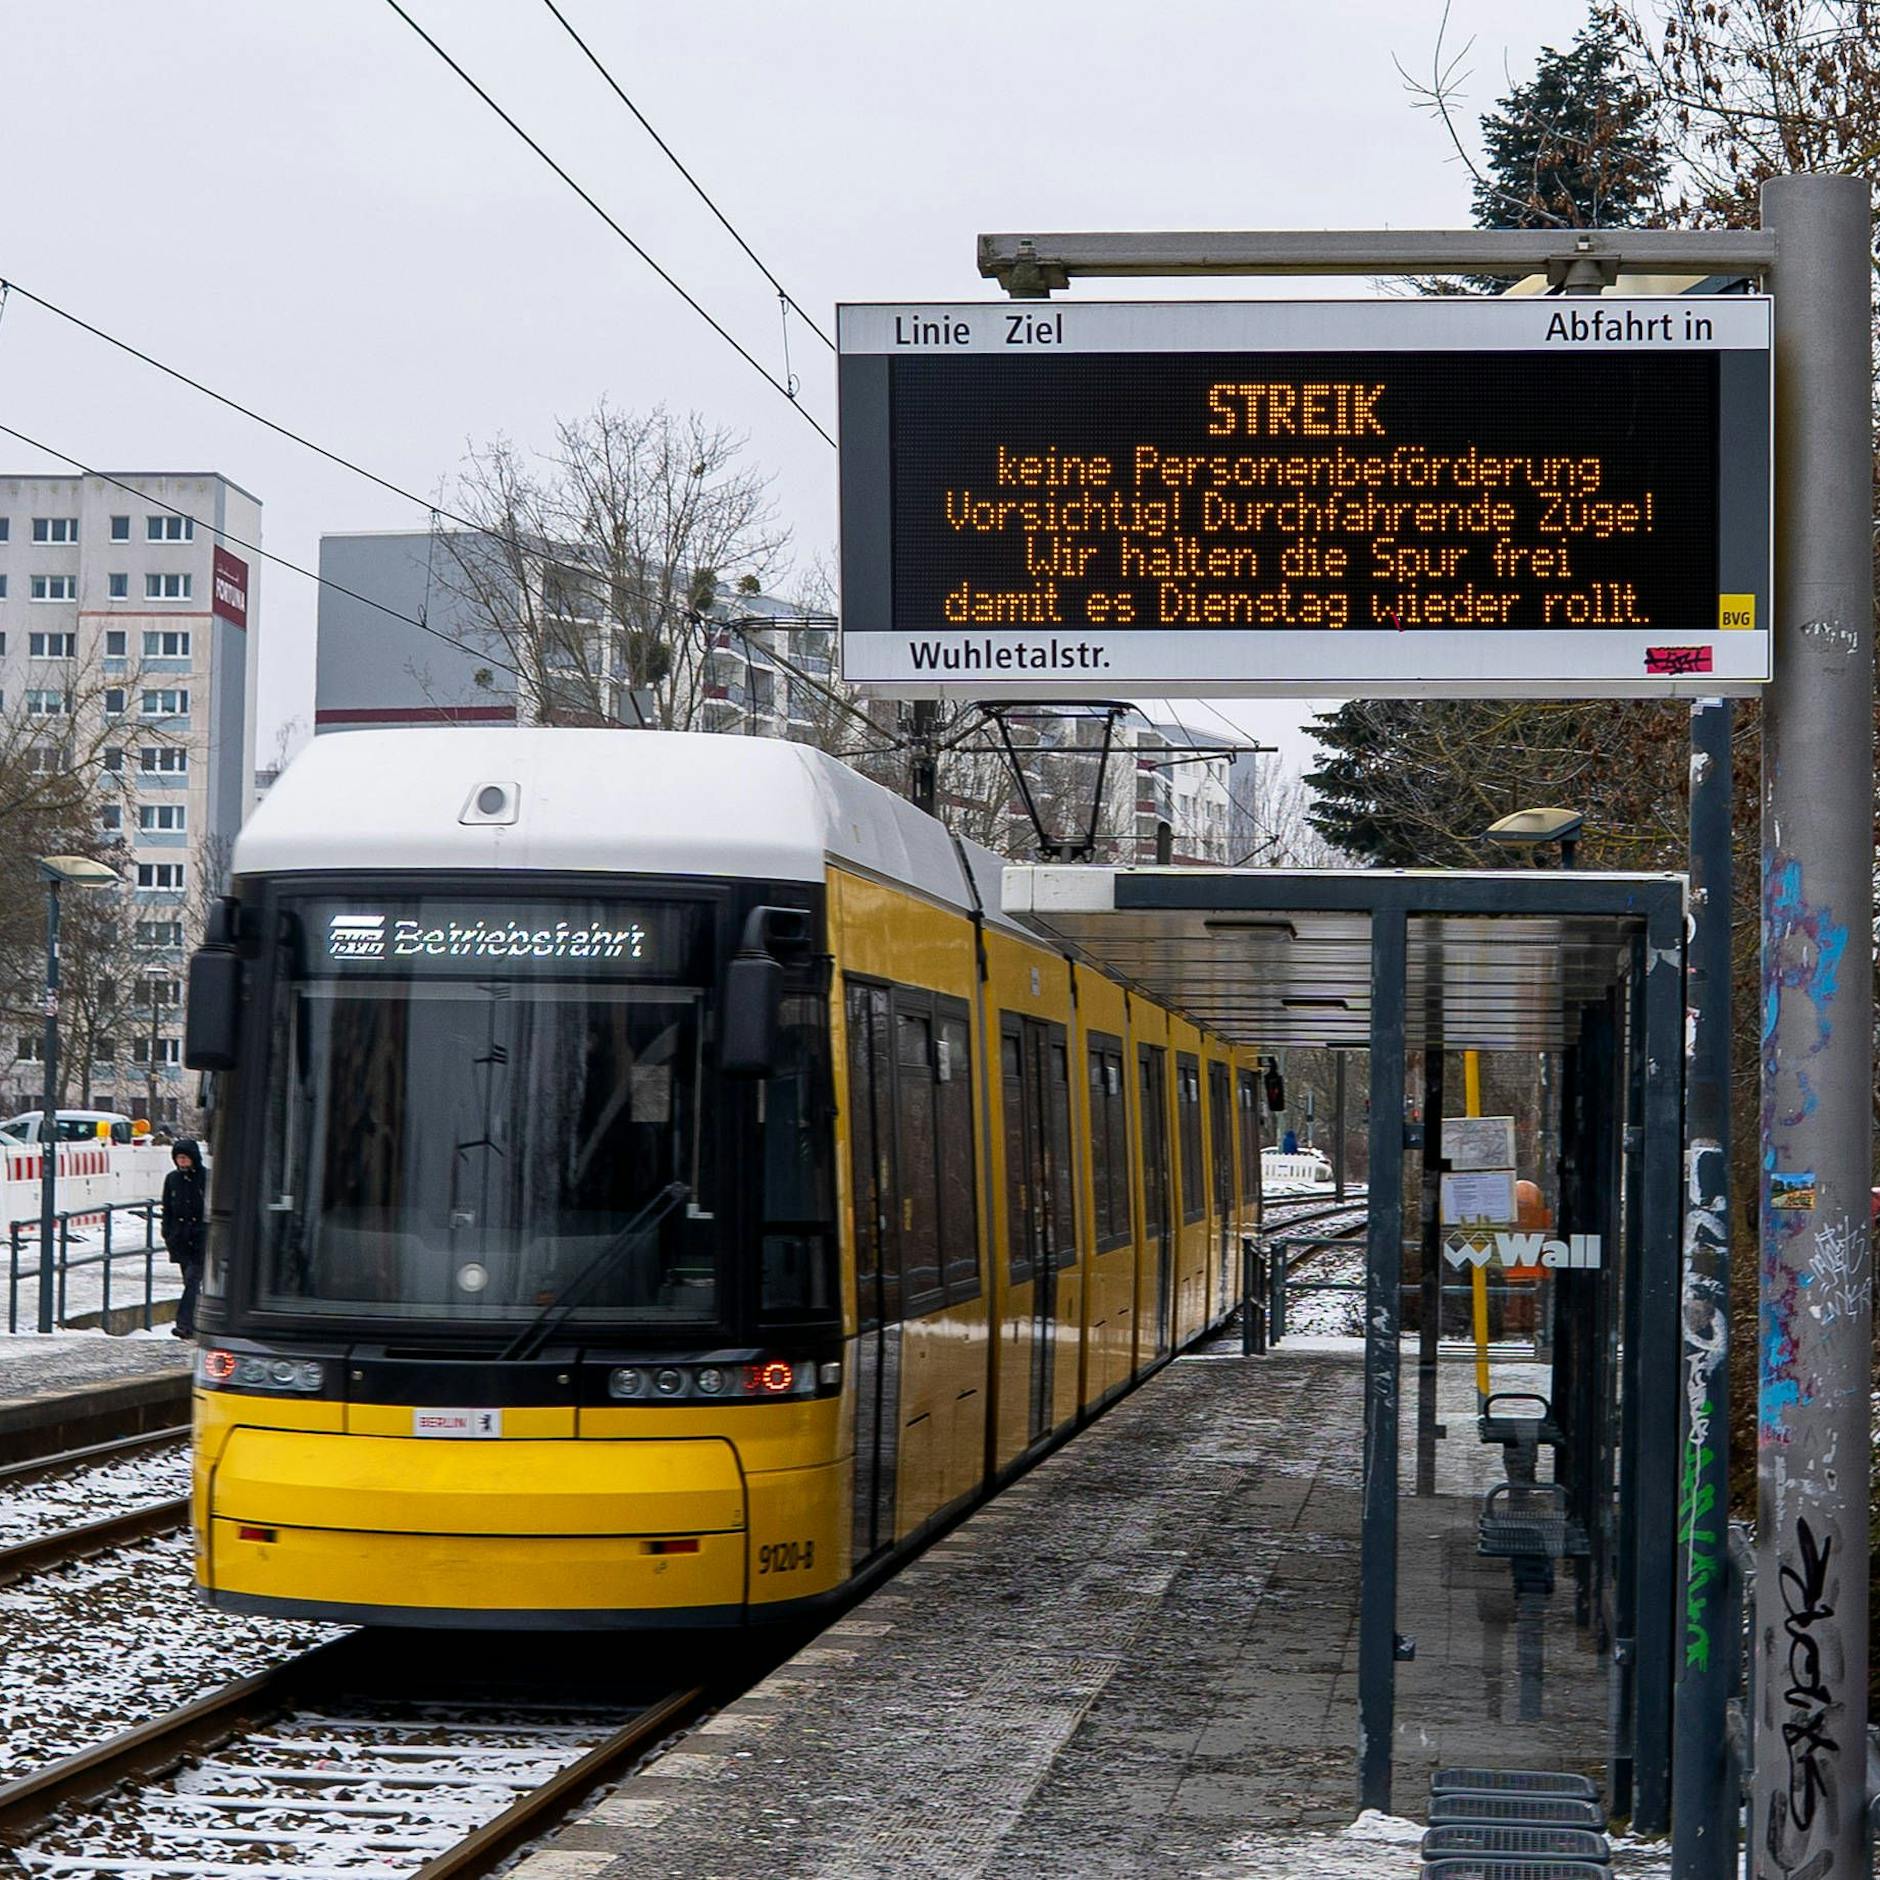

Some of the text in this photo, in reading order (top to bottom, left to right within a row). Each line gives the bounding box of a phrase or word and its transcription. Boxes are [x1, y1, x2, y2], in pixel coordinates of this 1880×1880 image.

[894, 313, 1064, 346] Linie Ziel
[1544, 310, 1714, 342] Abfahrt in
[1208, 383, 1387, 436] STREIK
[998, 445, 1600, 493] keine Personenbeförderung
[946, 490, 1653, 538] Vorsichtig! Durchfahrende Züge!
[1027, 536, 1573, 583] Wir halten die Spur frei
[945, 581, 1651, 629] damit es Dienstag wieder rollt.
[1722, 611, 1751, 626] BVG
[909, 638, 1111, 670] Wuhletalstr.
[394, 920, 646, 957] Betriebsfahrt
[1495, 1232, 1602, 1269] Wall
[419, 1416, 467, 1428] BERLIN
